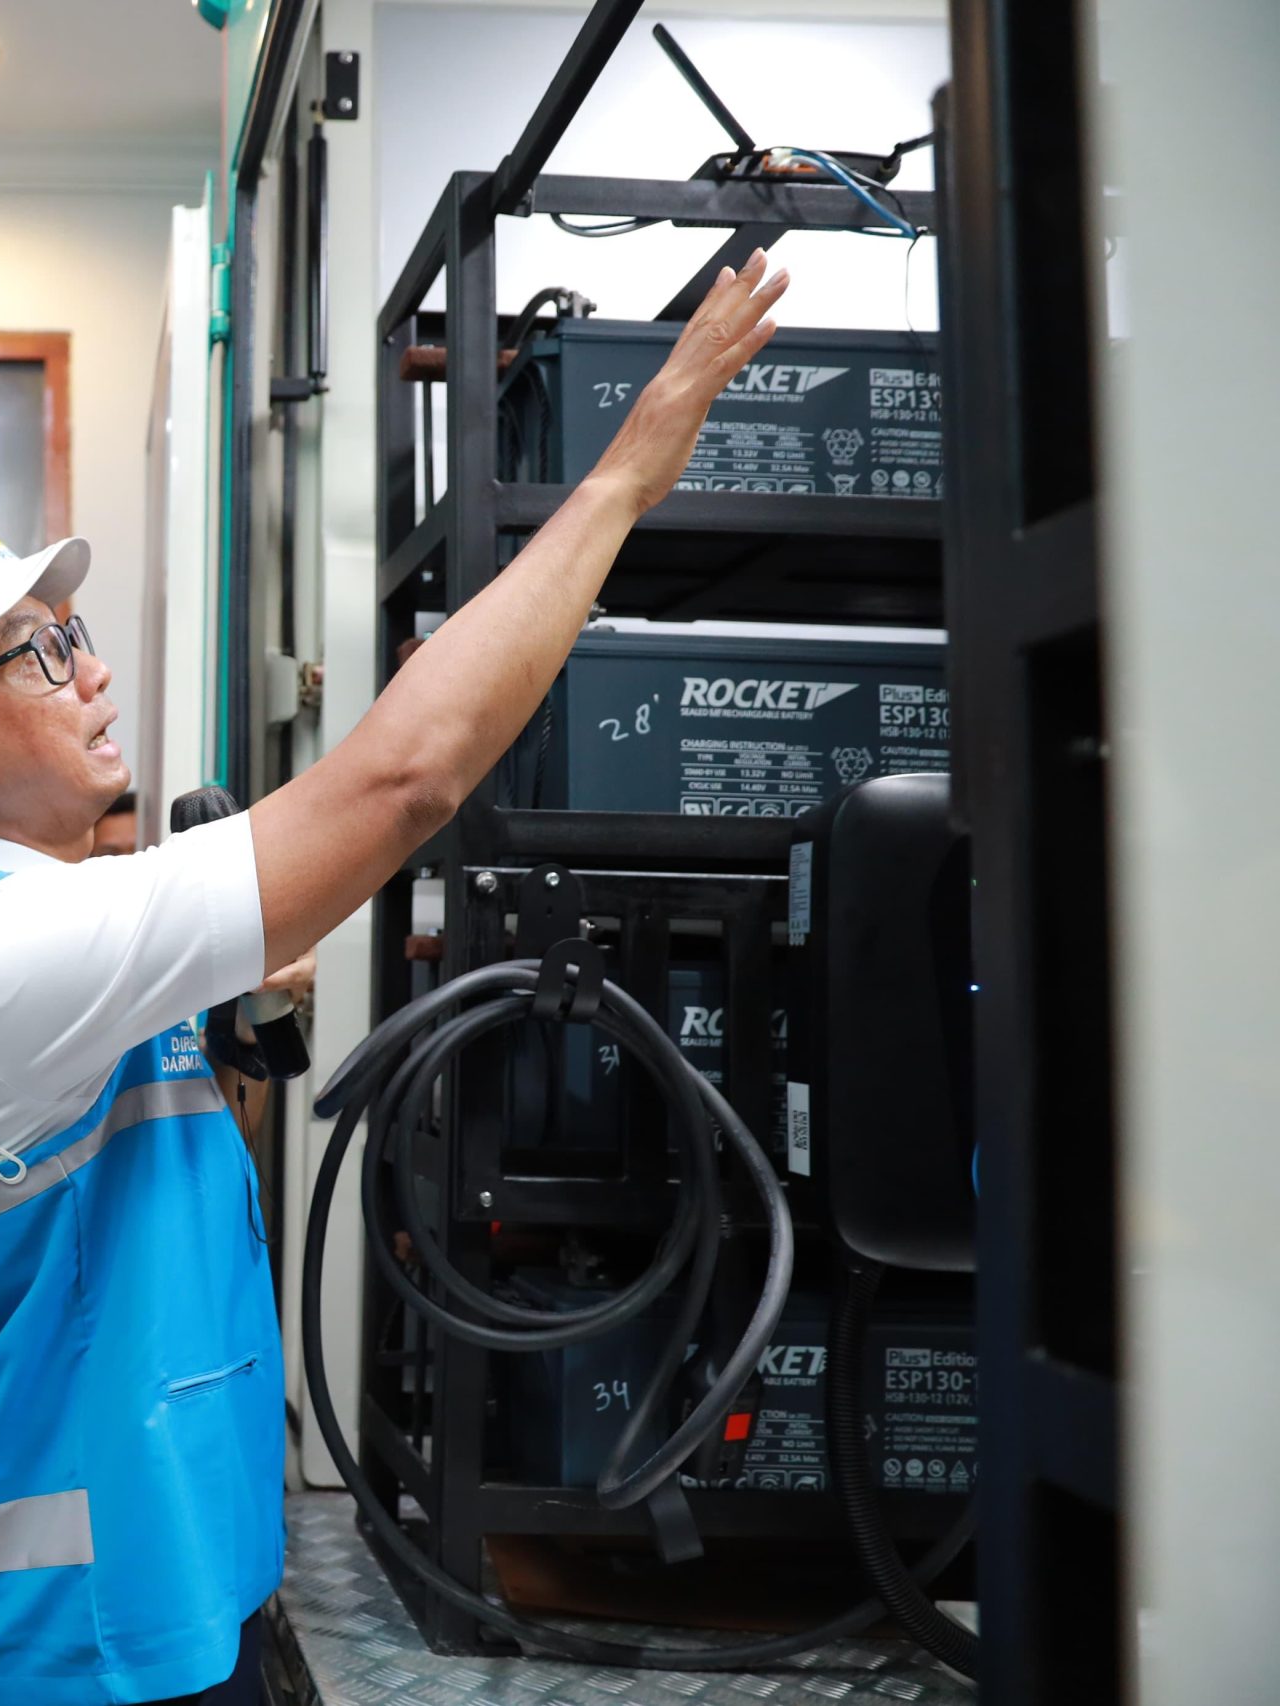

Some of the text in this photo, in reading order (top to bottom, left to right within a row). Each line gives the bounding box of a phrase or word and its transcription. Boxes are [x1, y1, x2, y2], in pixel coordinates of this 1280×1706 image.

[727, 364, 818, 393] CKET
[593, 382, 631, 408] 25
[680, 677, 827, 710] ROCKET
[757, 1345, 827, 1375] KET
[933, 1351, 977, 1367] Editio
[593, 1380, 630, 1411] 34
